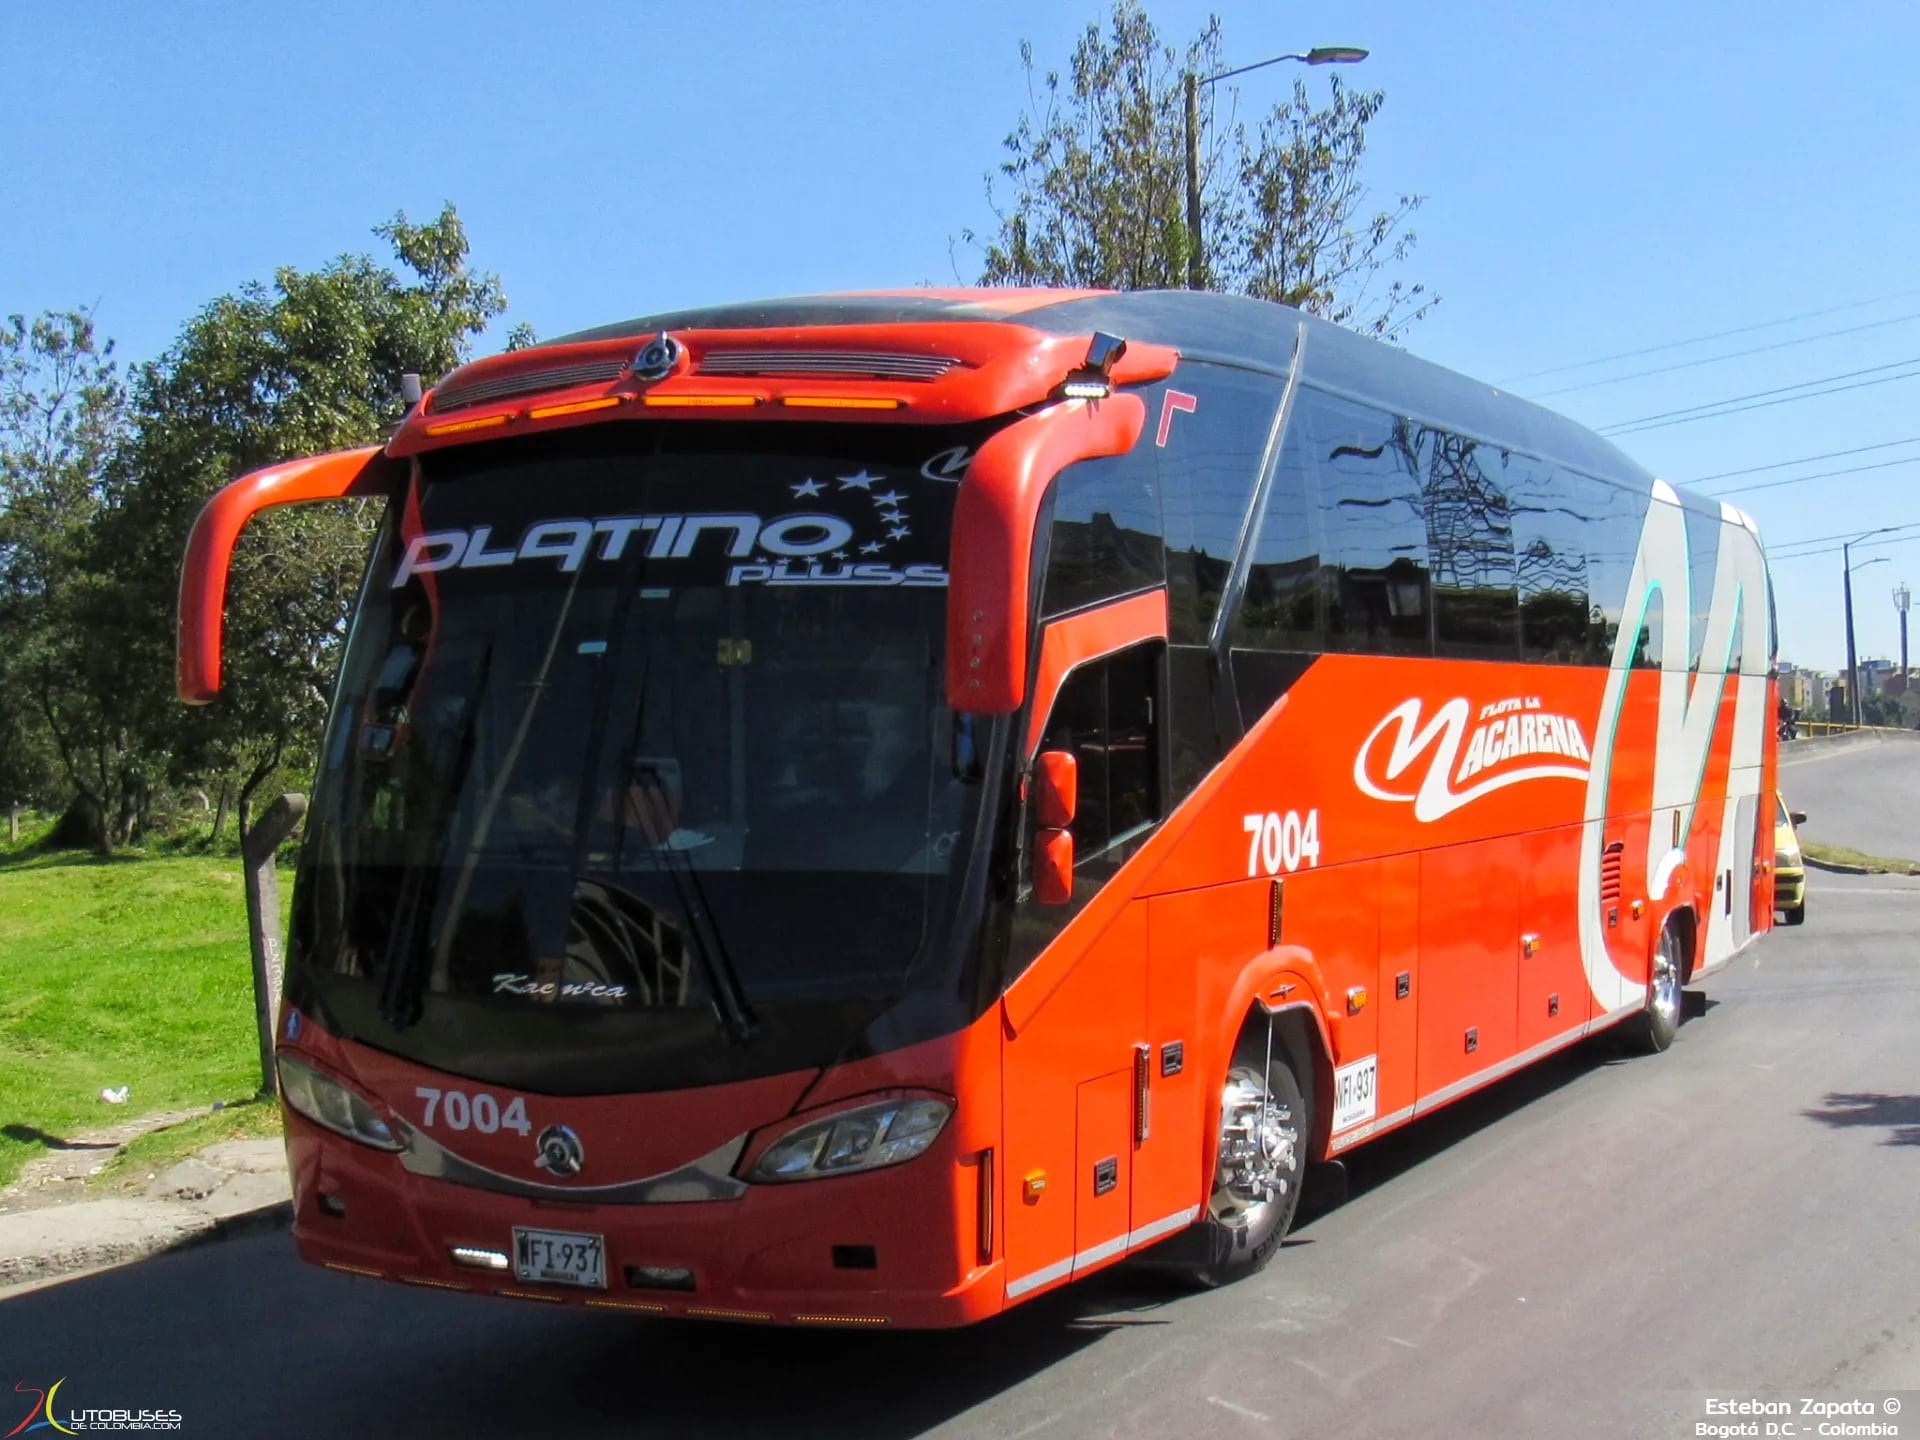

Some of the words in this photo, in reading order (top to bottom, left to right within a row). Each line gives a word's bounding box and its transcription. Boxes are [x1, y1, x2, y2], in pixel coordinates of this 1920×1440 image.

[391, 513, 853, 588] PLATINO
[727, 564, 949, 586] PLUSS
[1479, 698, 1521, 720] FLOTA
[1525, 697, 1541, 709] LA
[1244, 809, 1320, 876] 7004
[415, 1087, 531, 1136] 7004
